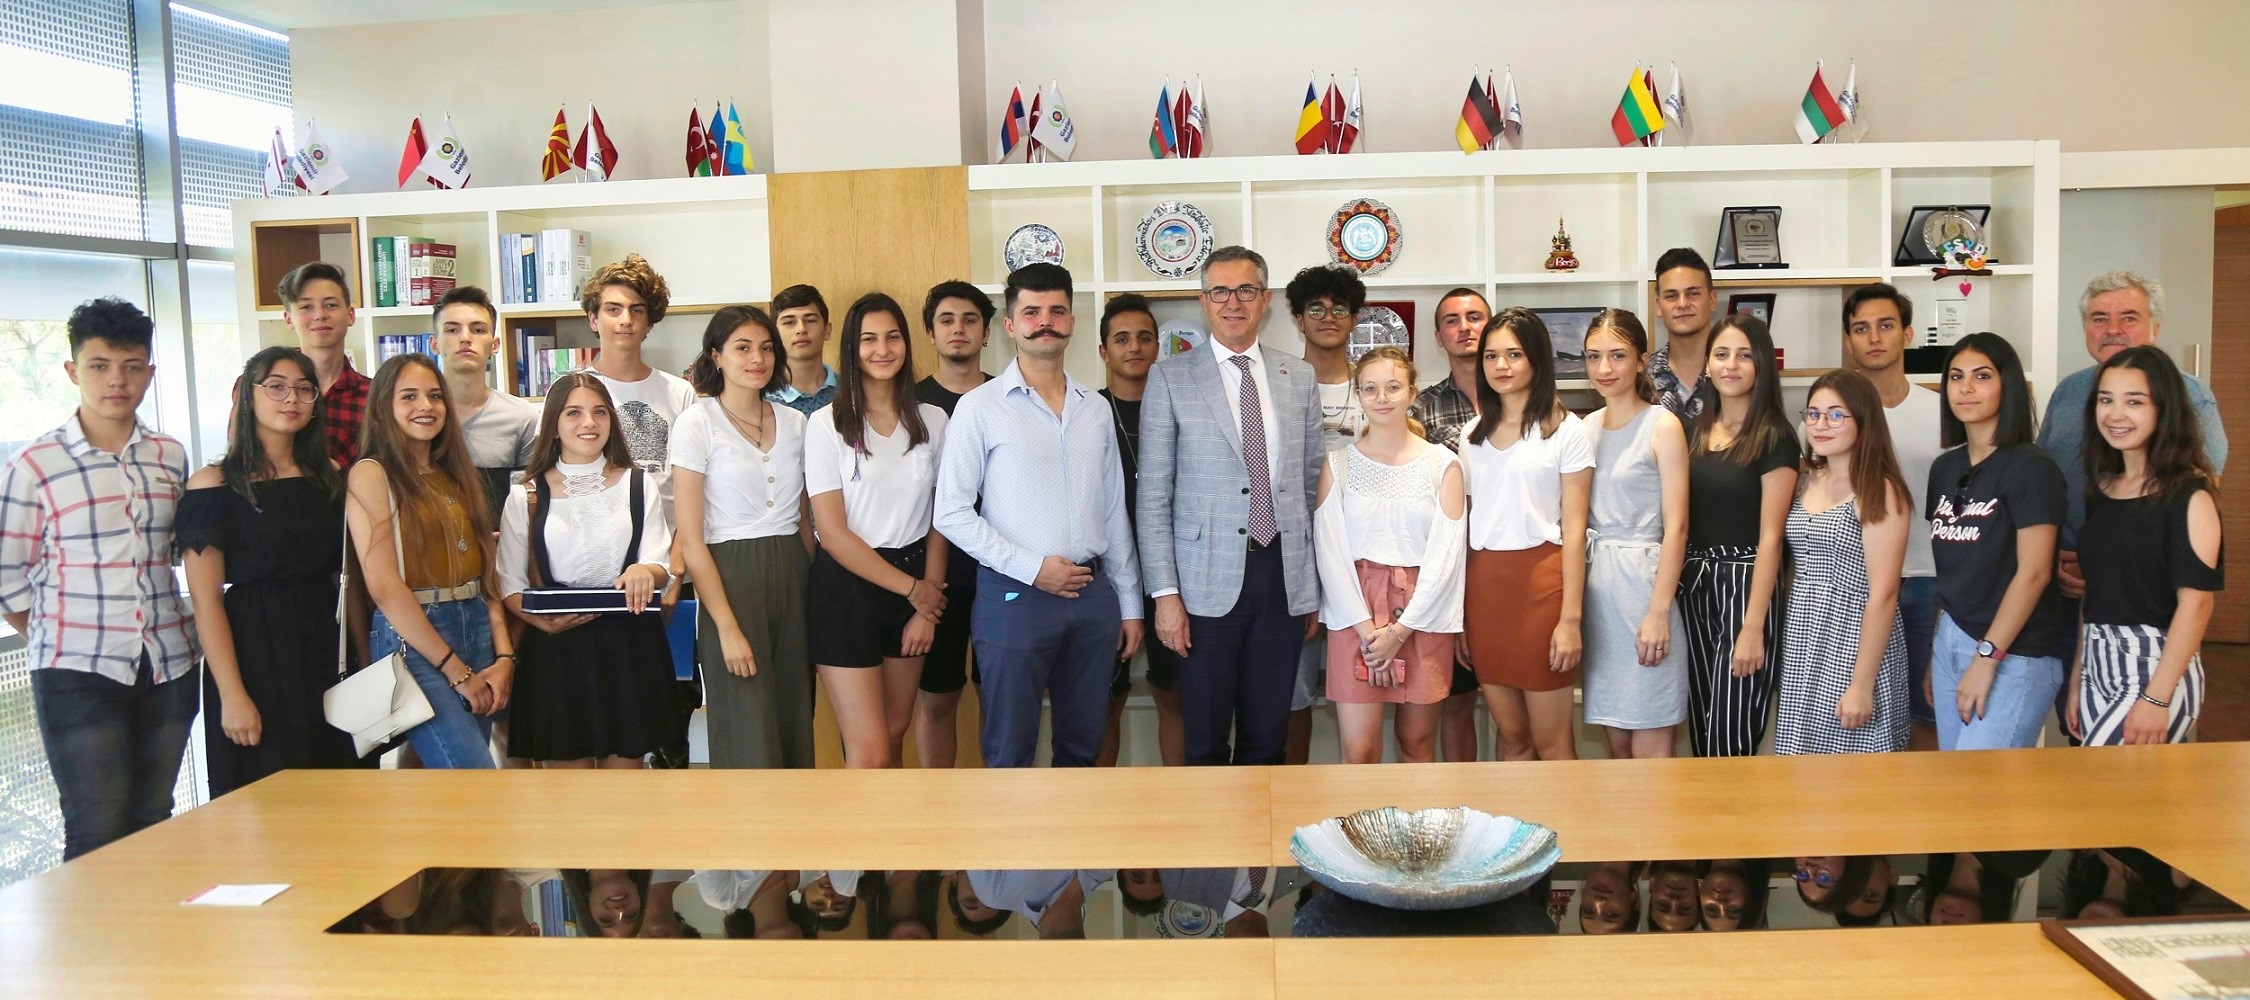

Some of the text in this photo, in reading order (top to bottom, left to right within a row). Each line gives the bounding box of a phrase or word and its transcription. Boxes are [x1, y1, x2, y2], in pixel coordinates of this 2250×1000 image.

[414, 268, 418, 276] 1
[447, 260, 455, 277] 2
[1933, 494, 1998, 523] riinal
[1930, 518, 1980, 541] Person
